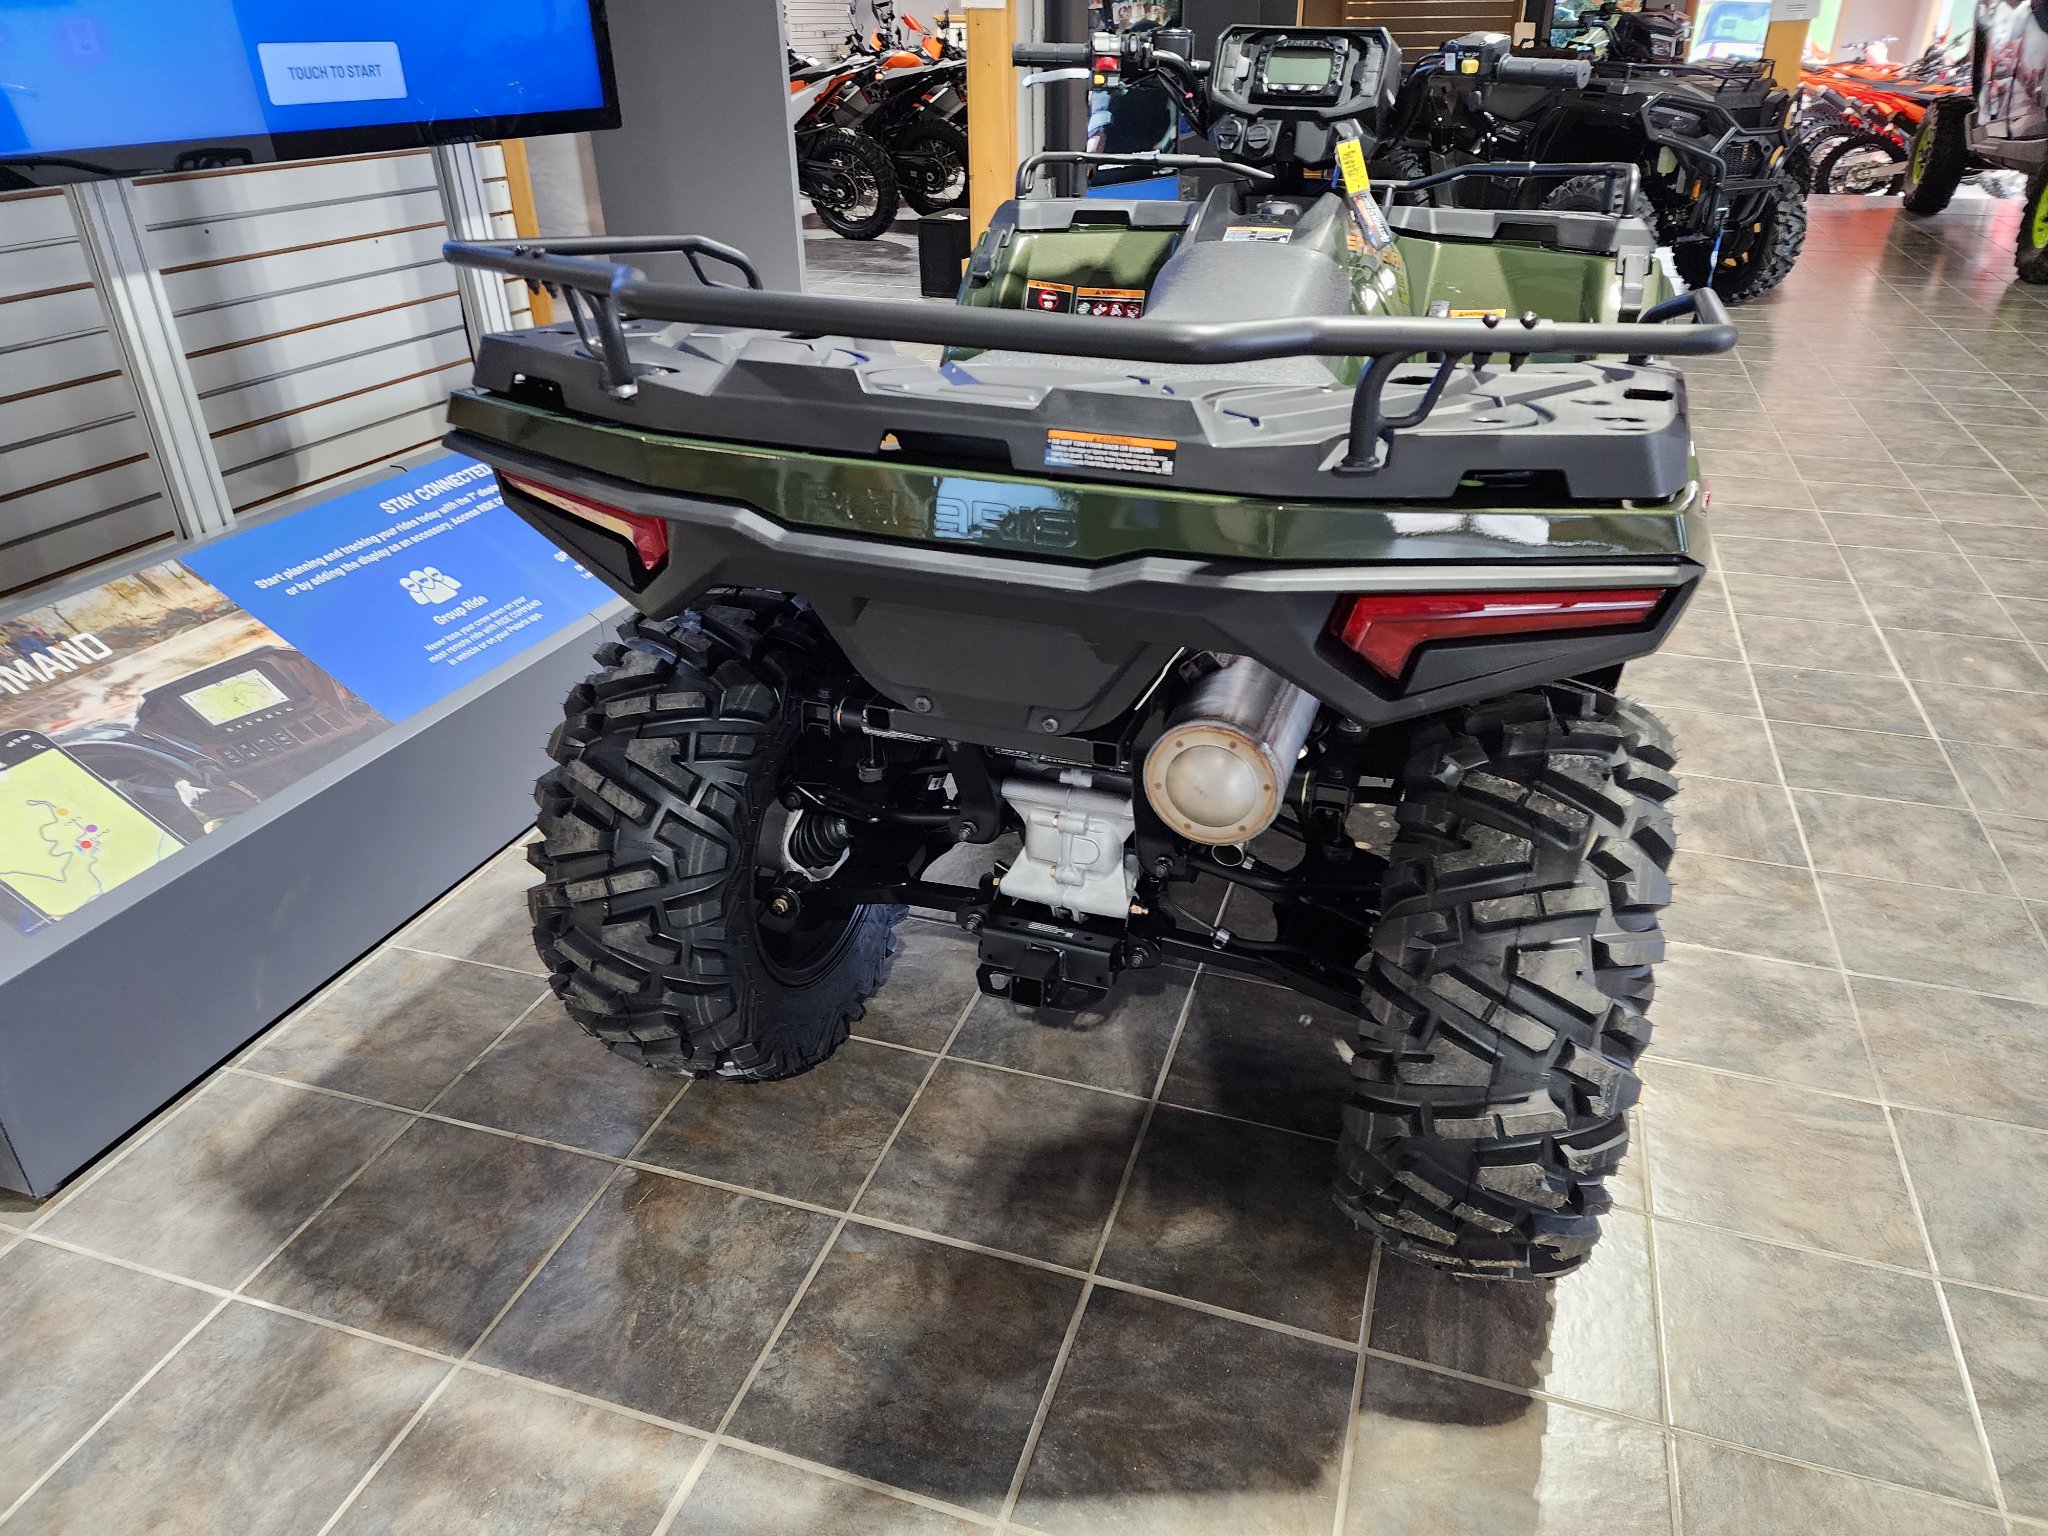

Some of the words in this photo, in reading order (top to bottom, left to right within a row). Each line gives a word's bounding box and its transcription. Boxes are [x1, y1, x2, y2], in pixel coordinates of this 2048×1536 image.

[287, 65, 329, 81] TOUCH
[330, 65, 345, 79] TO
[347, 64, 382, 78] START
[380, 492, 420, 515] STAY
[415, 463, 495, 501] CONNECTED
[254, 572, 287, 589] Start
[282, 556, 328, 580] planning
[323, 548, 344, 562] and
[340, 534, 382, 555] tracking
[376, 526, 399, 541] your
[395, 518, 420, 533] rides
[415, 509, 442, 524] today
[439, 501, 460, 515] with
[455, 494, 473, 506] the
[285, 584, 300, 596] or
[295, 580, 314, 591] by
[309, 566, 347, 586] adding
[340, 560, 361, 572] the
[357, 547, 392, 565] display
[388, 543, 402, 553] as
[399, 538, 415, 548] an
[450, 508, 481, 526] Access
[475, 500, 499, 513] RIDE
[424, 635, 448, 652] Never
[443, 630, 463, 642] lose
[459, 623, 476, 636] your
[503, 602, 516, 611] on
[511, 595, 528, 608] your
[428, 649, 449, 664] most
[445, 638, 472, 655] remote
[469, 630, 486, 642] ride
[481, 623, 500, 635] with
[494, 614, 514, 628] RIDE
[509, 599, 544, 619] COMMAND
[432, 606, 468, 625] Group
[460, 595, 490, 611] Ride
[454, 645, 482, 662] vehicle
[478, 640, 489, 650] or
[485, 636, 499, 646] on
[493, 629, 511, 643] your
[506, 619, 532, 633] Polaris
